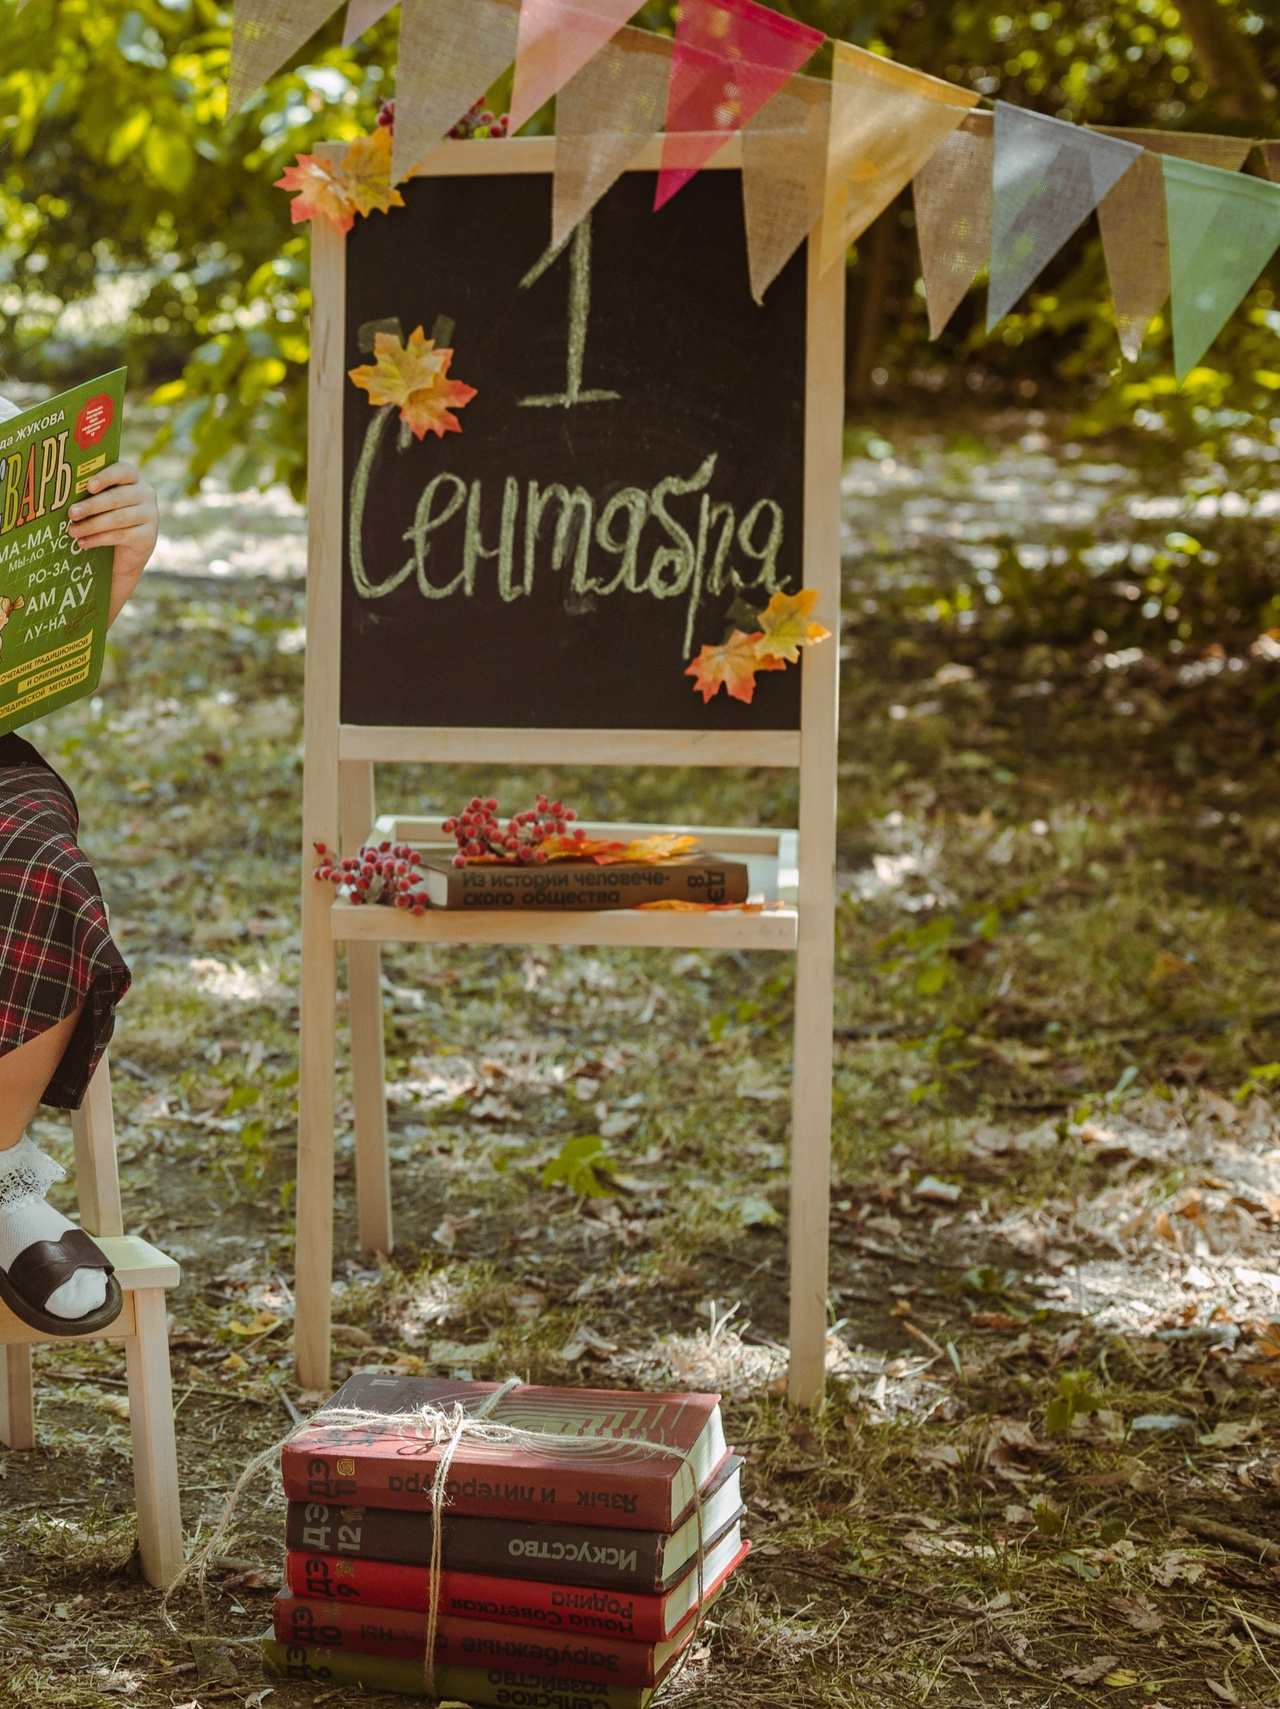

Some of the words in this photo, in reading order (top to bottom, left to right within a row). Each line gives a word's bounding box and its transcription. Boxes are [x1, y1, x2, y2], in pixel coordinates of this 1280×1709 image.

[519, 211, 621, 408] 1
[15, 410, 65, 442] ЖУКОВА
[51, 536, 68, 553] УС
[9, 548, 44, 573] МЫ-ЛО
[28, 559, 70, 588] РО-ЗА
[71, 562, 93, 582] СА
[25, 587, 56, 616] АМ
[59, 577, 94, 614] АУ
[24, 614, 67, 643] ЛУ-НА
[34, 638, 89, 667] ТРАДИЦИОННОЙ
[27, 679, 32, 687] И
[33, 655, 87, 684] ОРИГИНАЛЬНОЙ
[48, 671, 85, 693] МЕТОДИКИ
[462, 872, 486, 889] Из
[491, 872, 569, 892] истории
[573, 871, 669, 887] человече-
[687, 874, 706, 887] 8
[463, 890, 515, 906] ского
[521, 888, 621, 909] общества
[307, 1458, 335, 1499] ДЭ
[334, 1478, 358, 1496] 11
[541, 1488, 556, 1504] и
[575, 1490, 639, 1514] Язык
[302, 1503, 331, 1550] ДЭ
[338, 1525, 362, 1551] 12
[508, 1539, 637, 1571] Искусство
[305, 1557, 336, 1598] ДЭ
[336, 1583, 360, 1597] 9
[450, 1597, 563, 1626] Советская
[551, 1591, 634, 1620] Родина
[291, 1605, 320, 1644] ДЭ
[321, 1625, 343, 1647] 10
[569, 1613, 634, 1636] Наша
[286, 1644, 314, 1680] ДЭ
[462, 1636, 619, 1673] Зарубежные
[487, 1670, 610, 1696] хозяйство
[497, 1688, 611, 1709] Сельское
